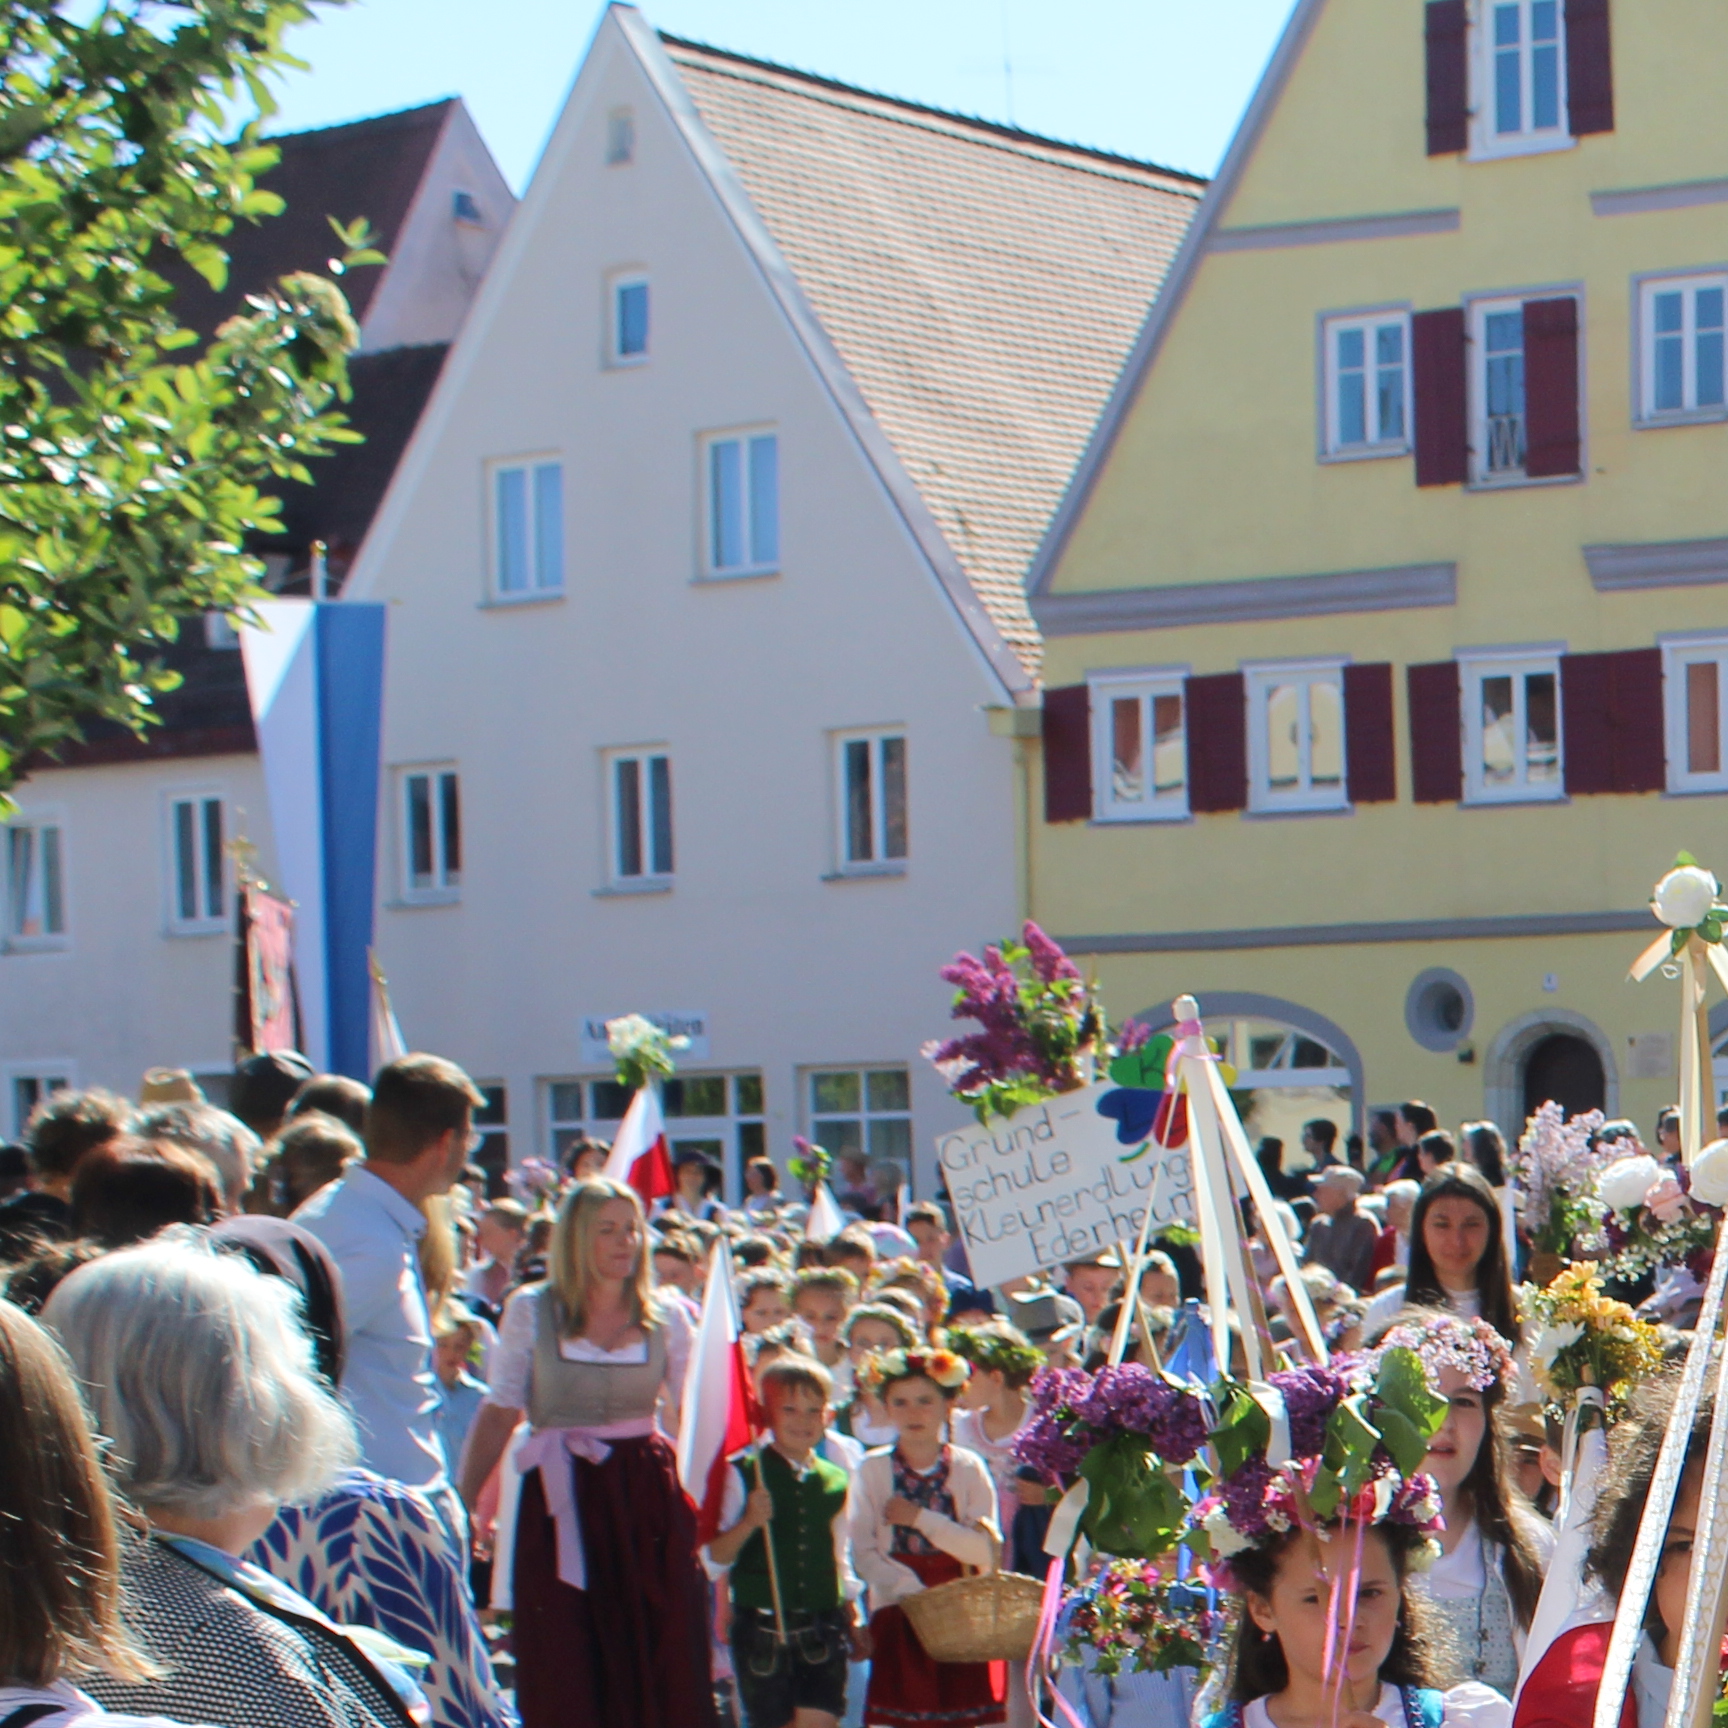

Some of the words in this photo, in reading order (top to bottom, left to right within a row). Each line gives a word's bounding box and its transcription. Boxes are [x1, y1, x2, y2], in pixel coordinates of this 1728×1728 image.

[955, 1148, 1071, 1211] schule
[959, 1153, 1194, 1248] Kleinerdling
[1028, 1187, 1197, 1265] Ederheim
